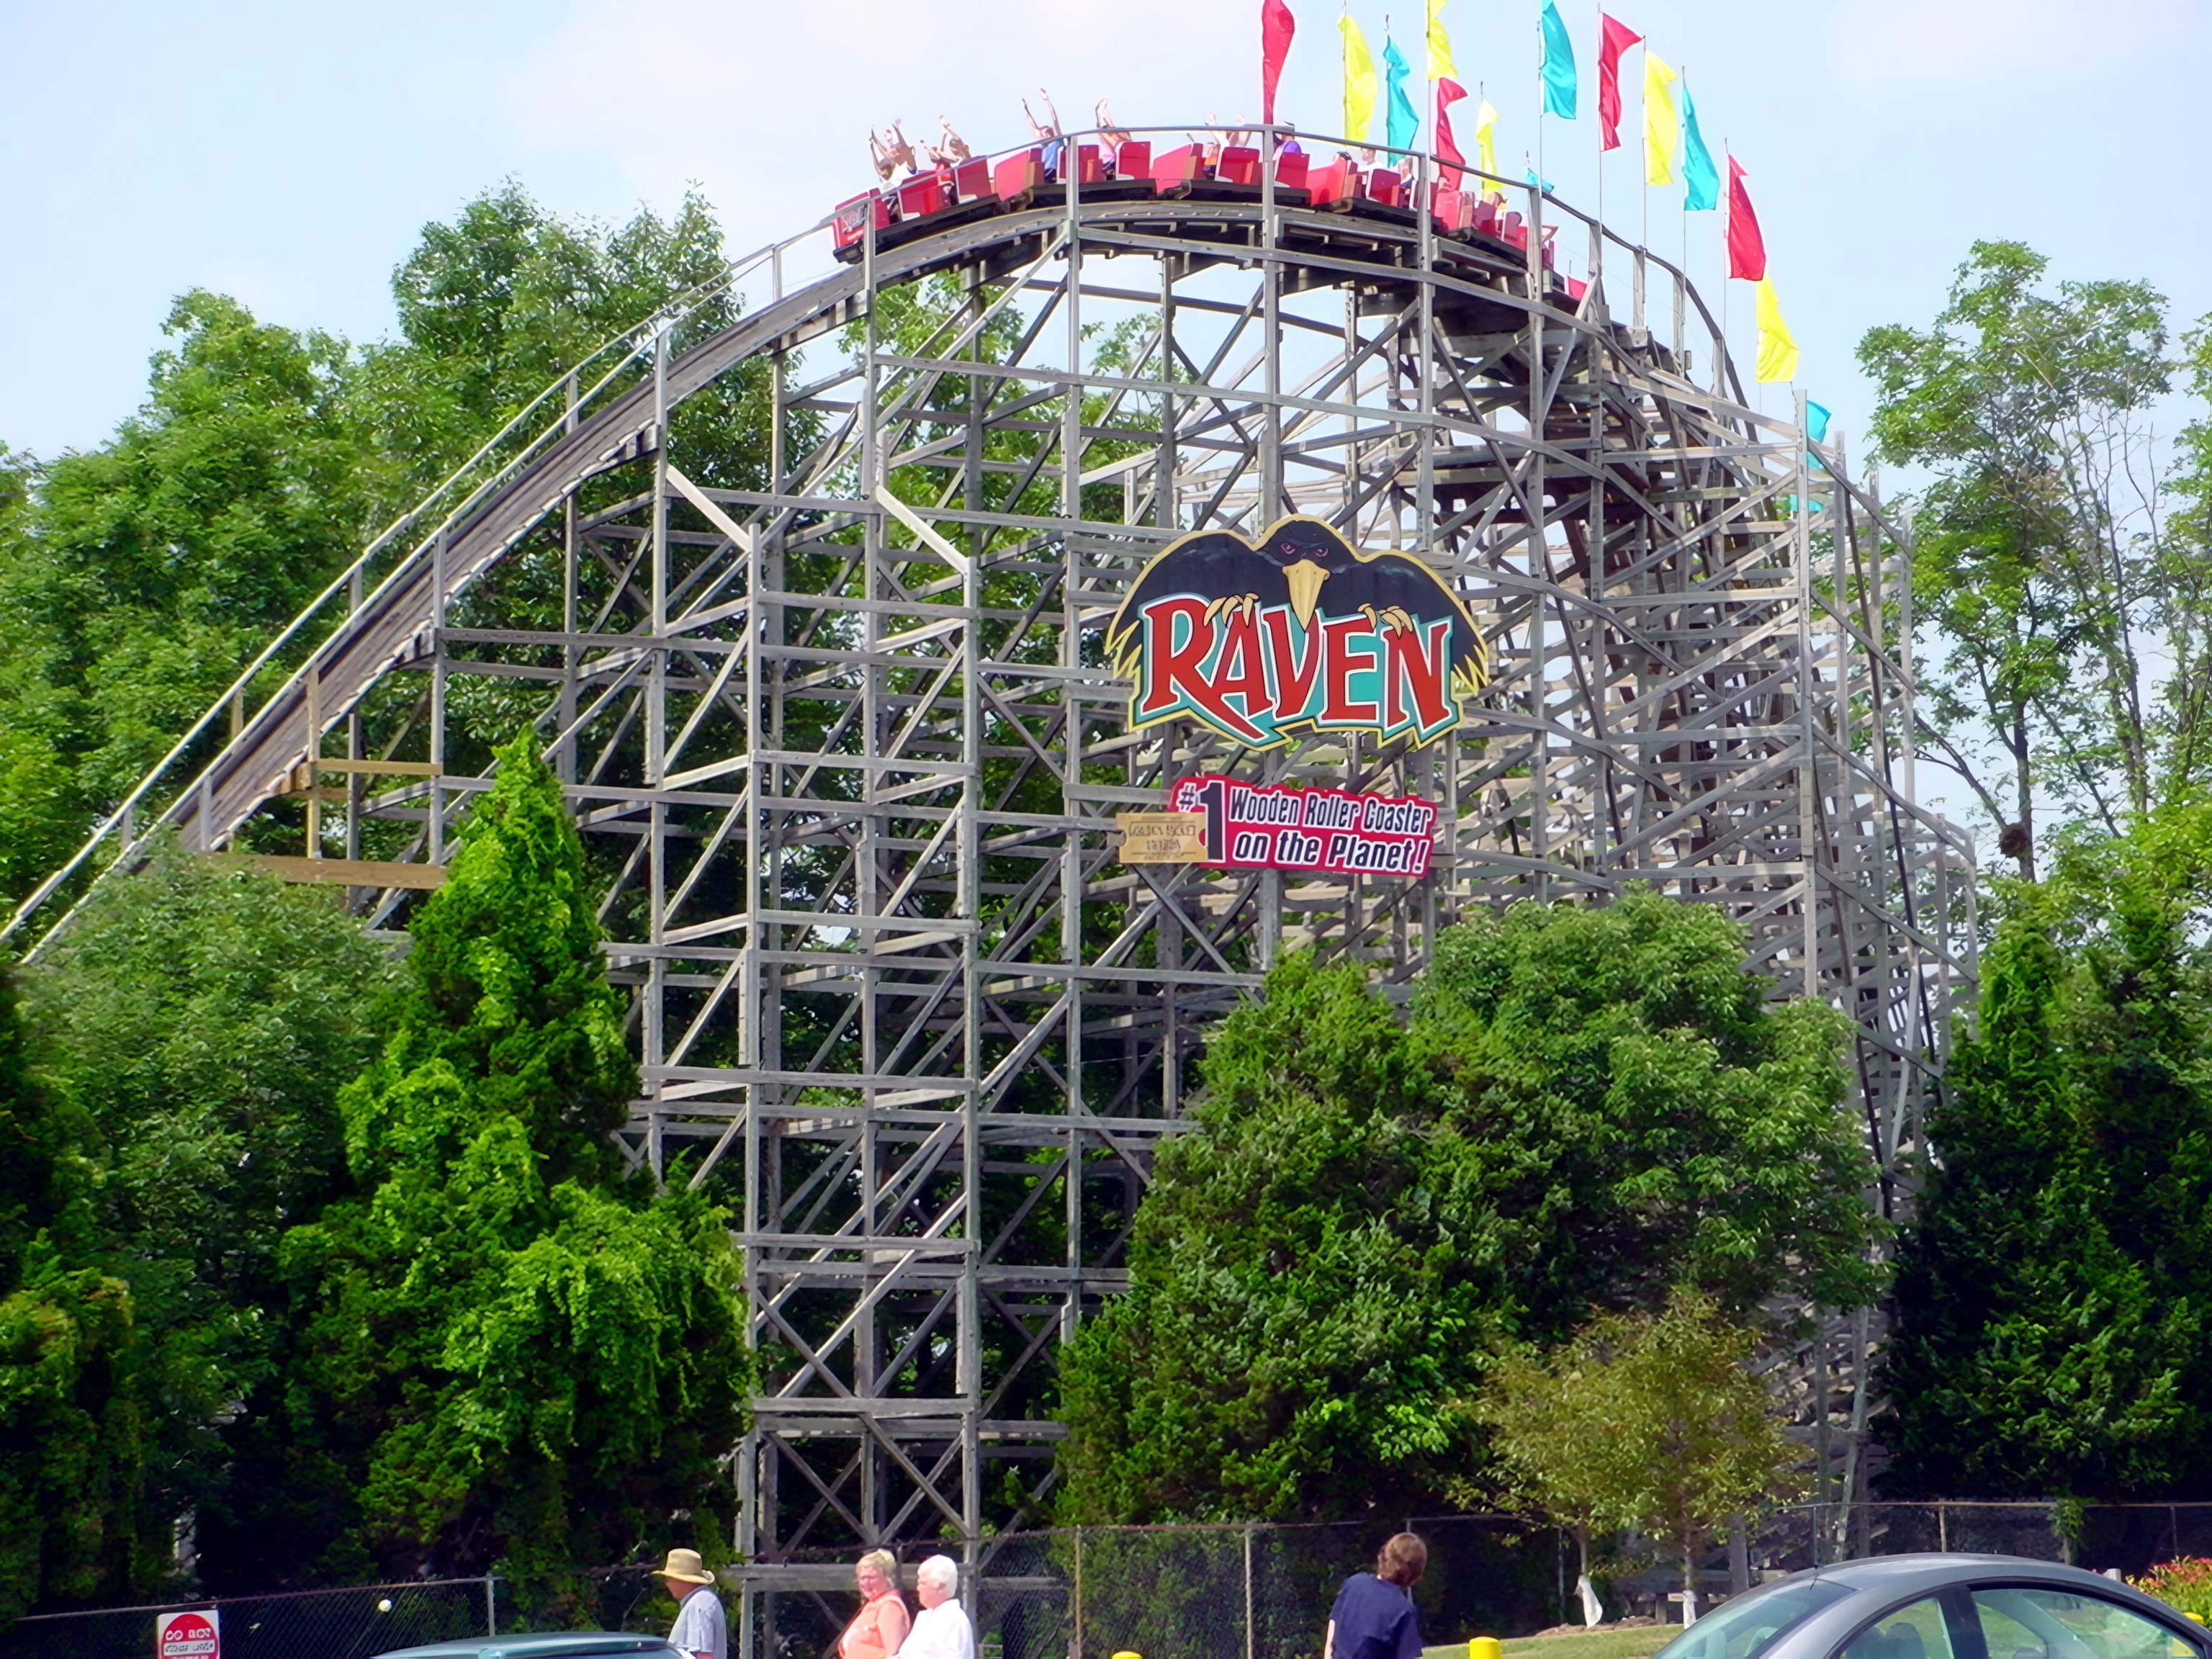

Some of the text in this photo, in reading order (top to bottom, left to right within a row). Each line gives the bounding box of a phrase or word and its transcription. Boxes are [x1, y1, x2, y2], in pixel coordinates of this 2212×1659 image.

[1141, 595, 1453, 740] RAVEN
[1230, 787, 1300, 825] Wooden
[1303, 793, 1360, 829] Roller
[1362, 797, 1431, 835] Coaster
[1233, 830, 1429, 872] on the Planet!
